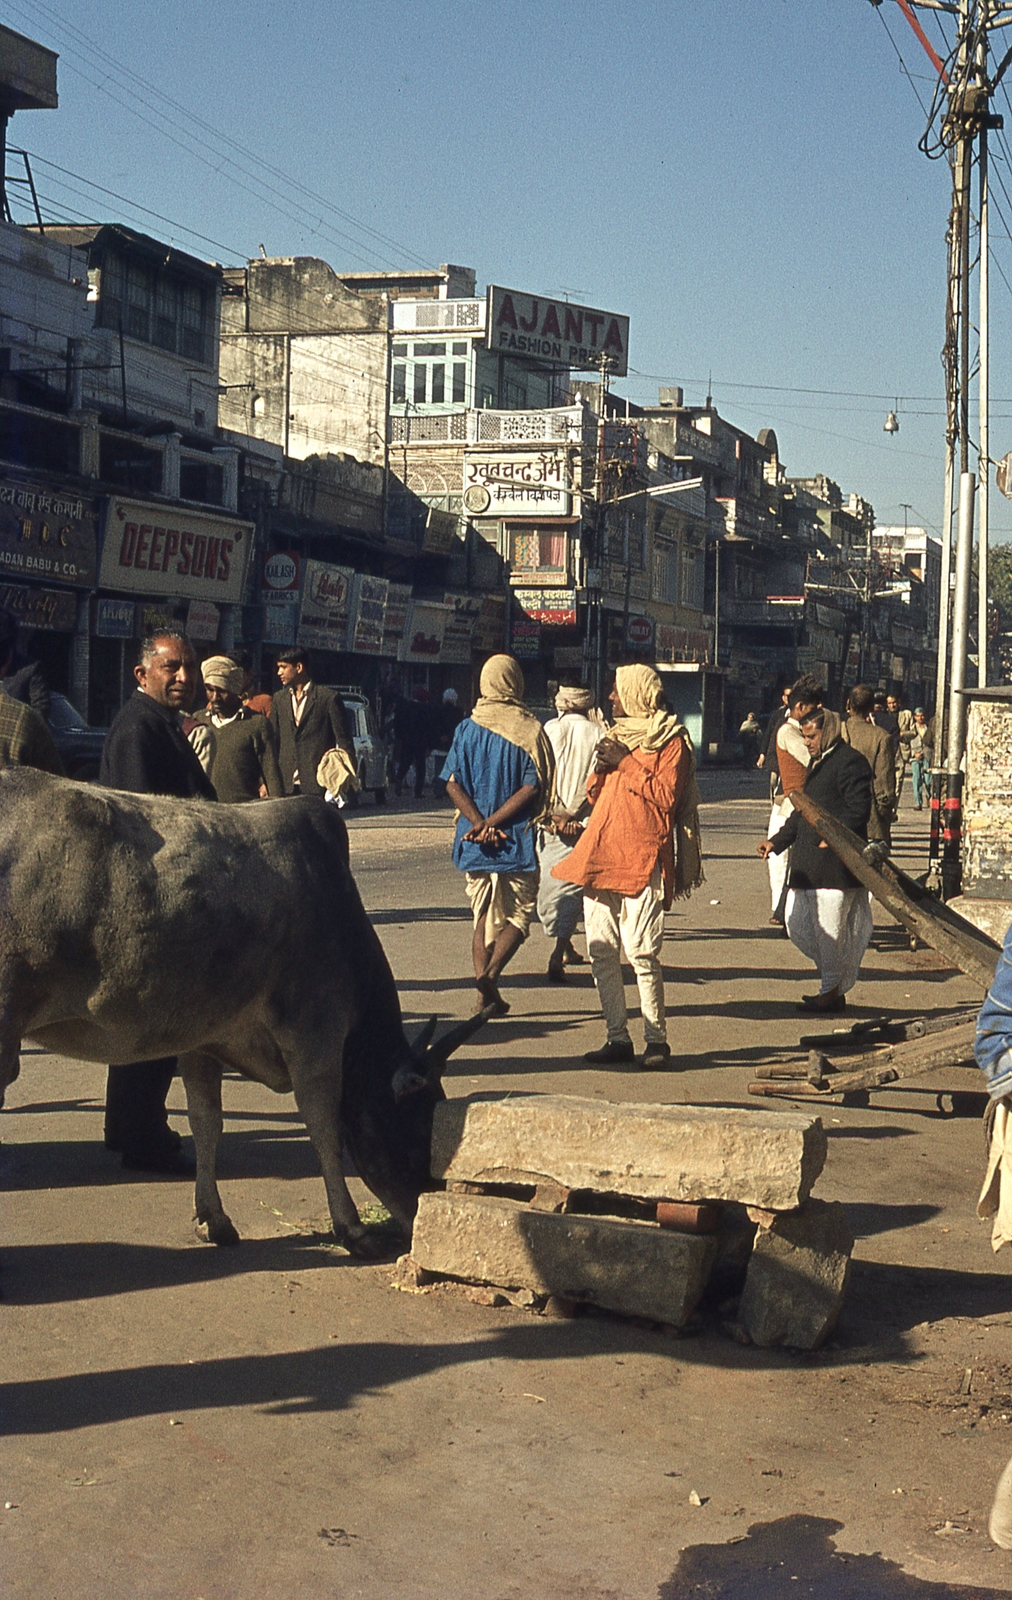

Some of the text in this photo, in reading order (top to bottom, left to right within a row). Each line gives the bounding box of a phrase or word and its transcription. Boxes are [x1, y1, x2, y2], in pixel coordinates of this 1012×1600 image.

[496, 294, 624, 353] AJANTA
[499, 331, 562, 358] FASHION
[26, 556, 51, 571] BABU
[53, 561, 60, 573] &
[62, 563, 78, 576] CO.
[265, 590, 295, 602] FABRICS
